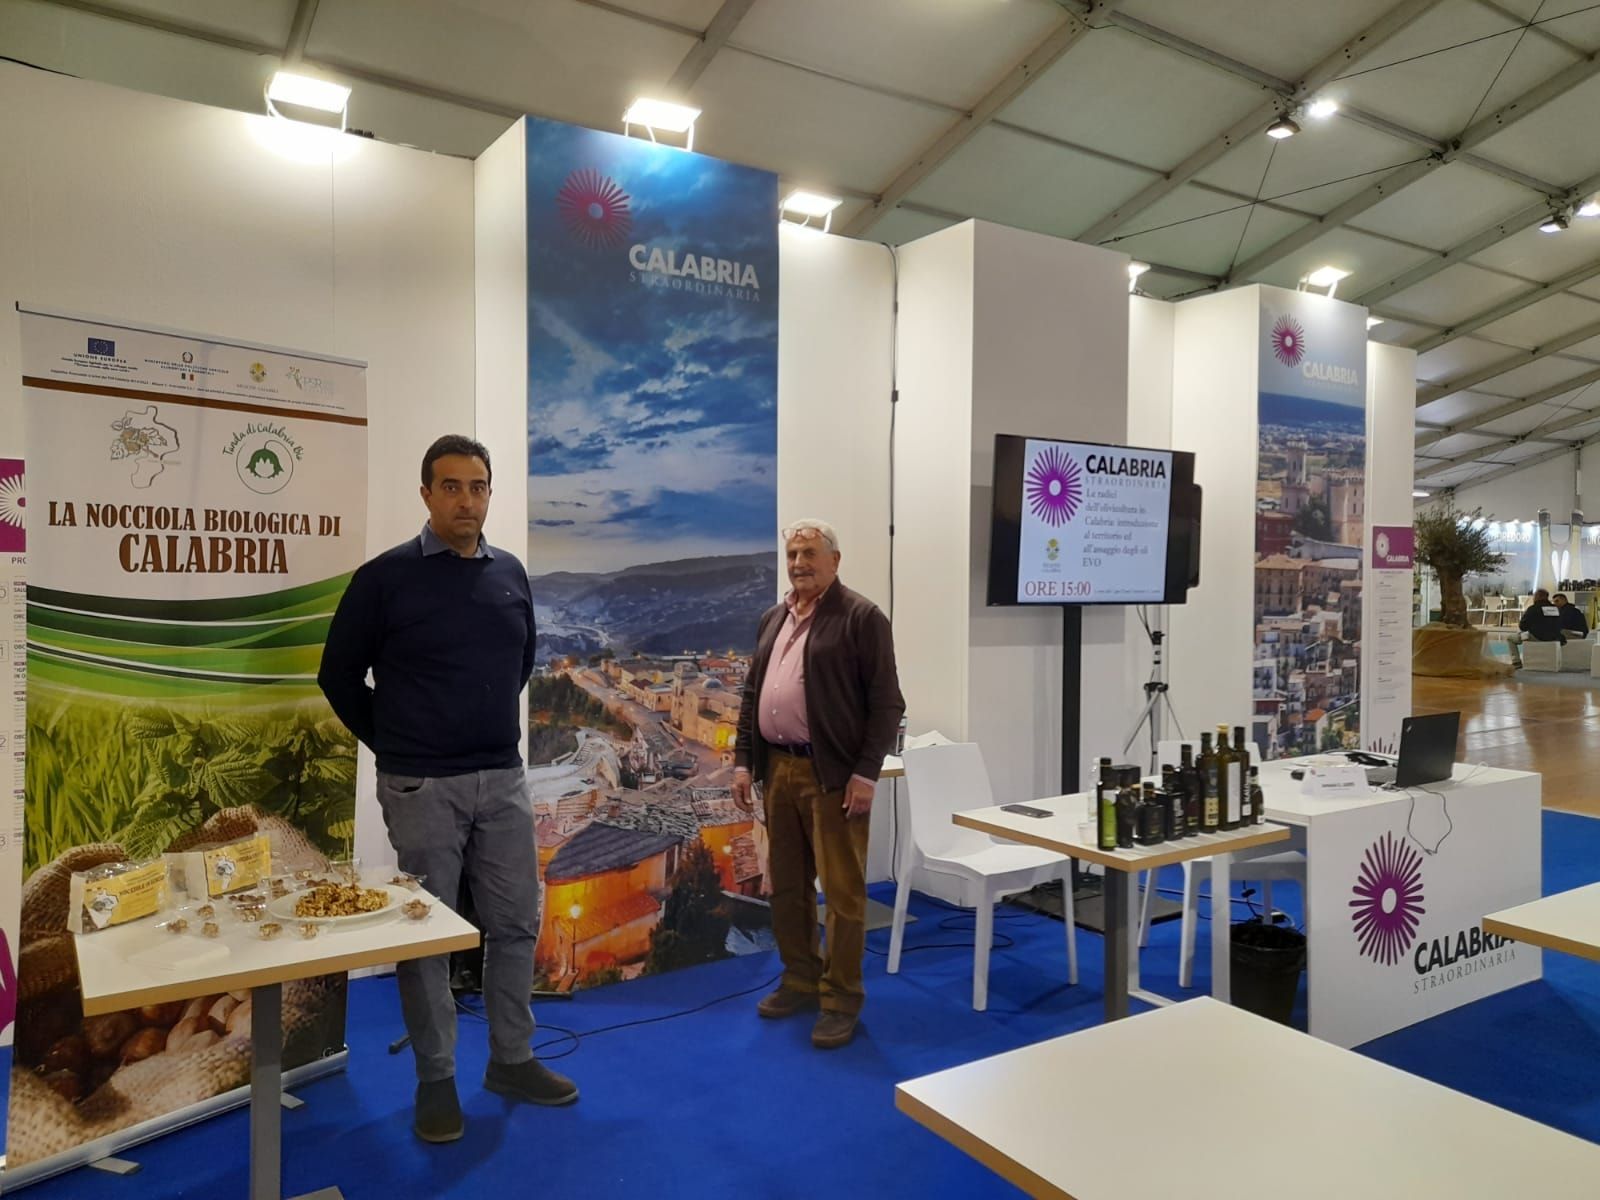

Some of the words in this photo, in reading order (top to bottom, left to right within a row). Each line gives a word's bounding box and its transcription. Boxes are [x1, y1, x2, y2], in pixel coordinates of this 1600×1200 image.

[629, 244, 760, 289] CALABRIA
[629, 272, 761, 302] STRAORDINARIA
[1303, 361, 1359, 386] CALABRIA
[257, 422, 295, 447] Calabria
[1086, 454, 1166, 479] CALABRIA
[1085, 476, 1167, 489] STRAORDINARIA
[48, 501, 77, 527] LA
[86, 503, 197, 531] NOCCIOLA
[204, 509, 311, 536] BIOLOGICA
[318, 514, 342, 537] DI
[119, 533, 289, 574] CALABRIA
[1082, 557, 1102, 568] EVO
[1025, 581, 1057, 597] ORE
[1060, 581, 1092, 597] 15:00
[1414, 926, 1515, 975] CALABR
[1413, 949, 1516, 994] STRAORDINARIA
